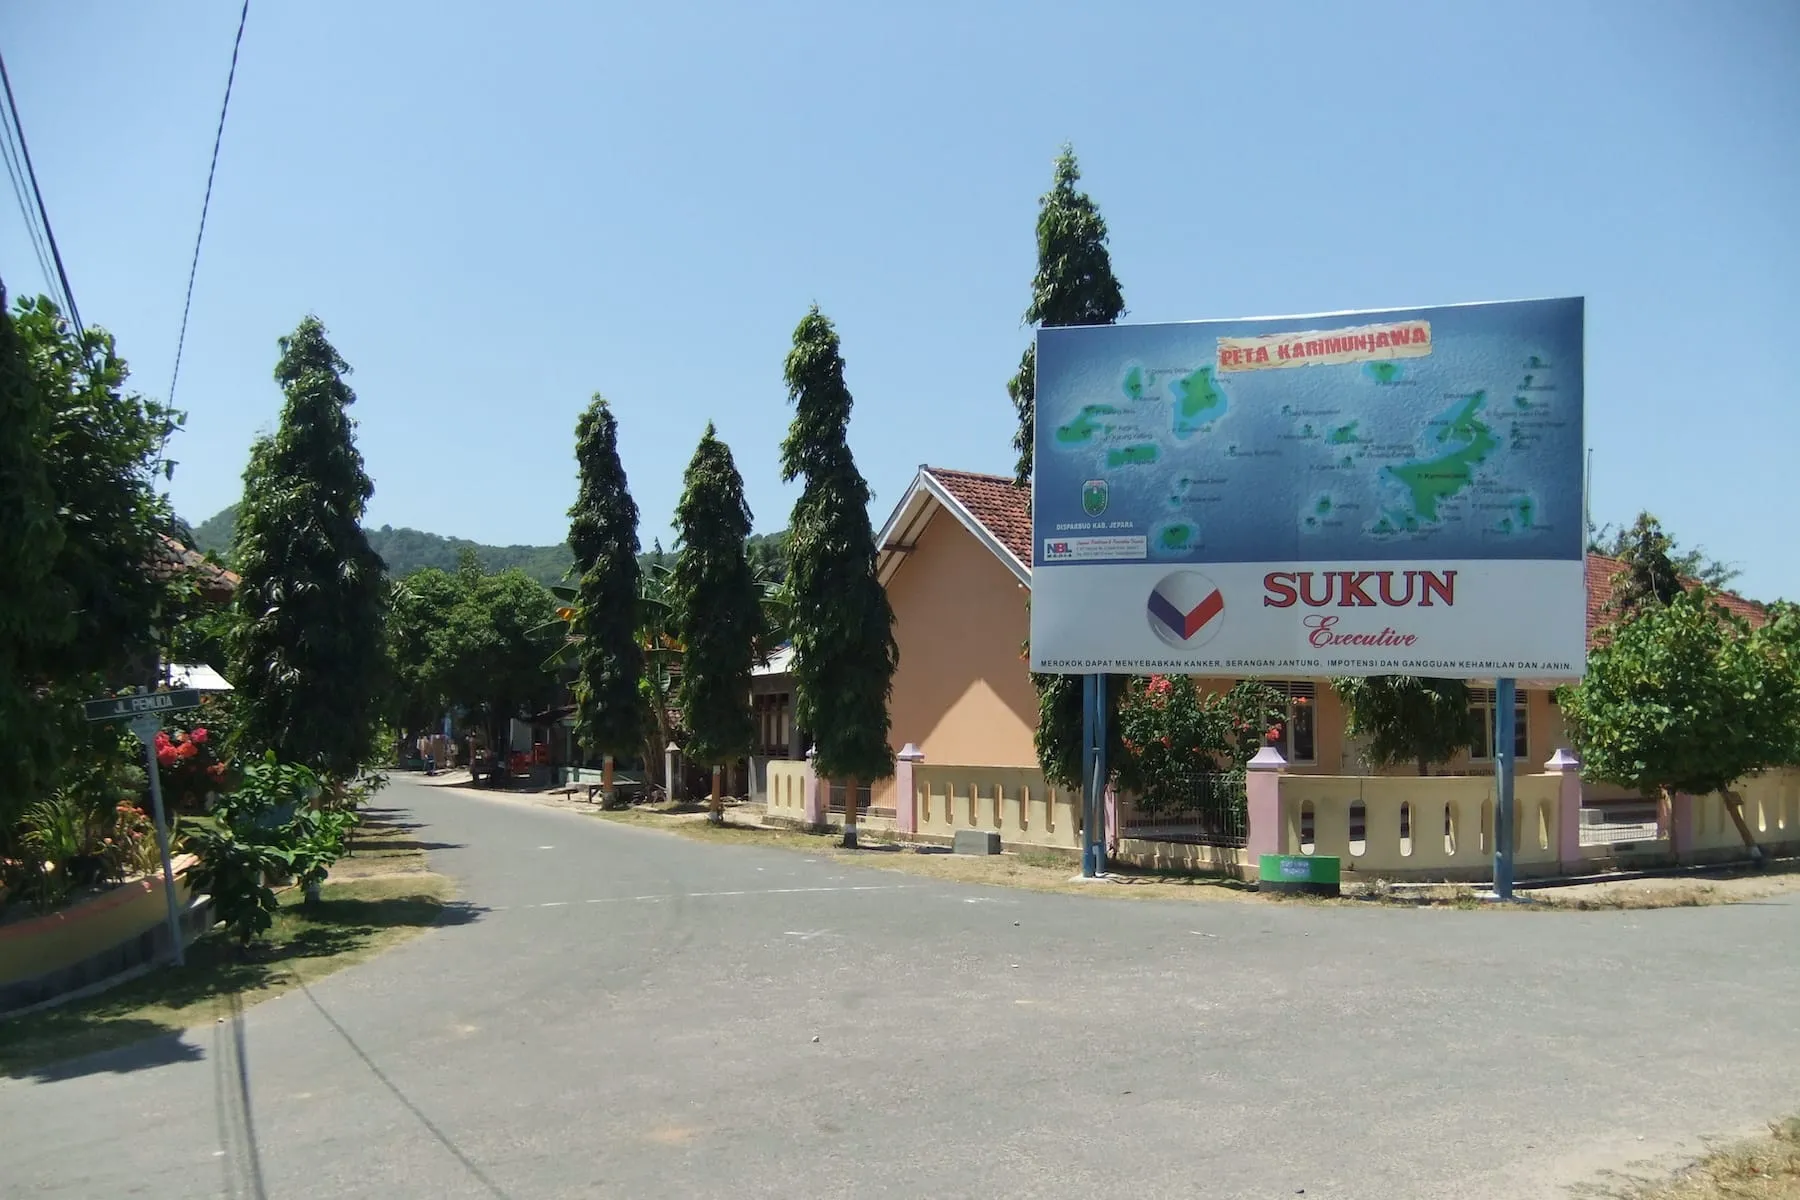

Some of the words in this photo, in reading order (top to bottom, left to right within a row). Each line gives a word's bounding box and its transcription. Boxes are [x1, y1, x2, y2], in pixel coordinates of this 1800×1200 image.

[1220, 345, 1270, 366] PETA
[1109, 521, 1133, 530] JEPARA
[1047, 542, 1072, 554] NBL
[1263, 570, 1458, 608] SUKUN
[1302, 613, 1418, 649] Executive
[1040, 659, 1083, 668] MEROKOK
[1085, 659, 1113, 668] DAPAT
[1115, 659, 1182, 668] MENYEBABKAN
[1226, 659, 1276, 667] SERANGAN
[1327, 659, 1378, 668] IMPOTENSI
[1380, 659, 1400, 668] DAN
[1401, 659, 1456, 668] GANGGUAN
[1458, 659, 1515, 669] KEHAMILAN
[1517, 660, 1538, 669] DAN
[1540, 661, 1573, 670] JANIN.
[132, 695, 173, 712] PEMUDA
